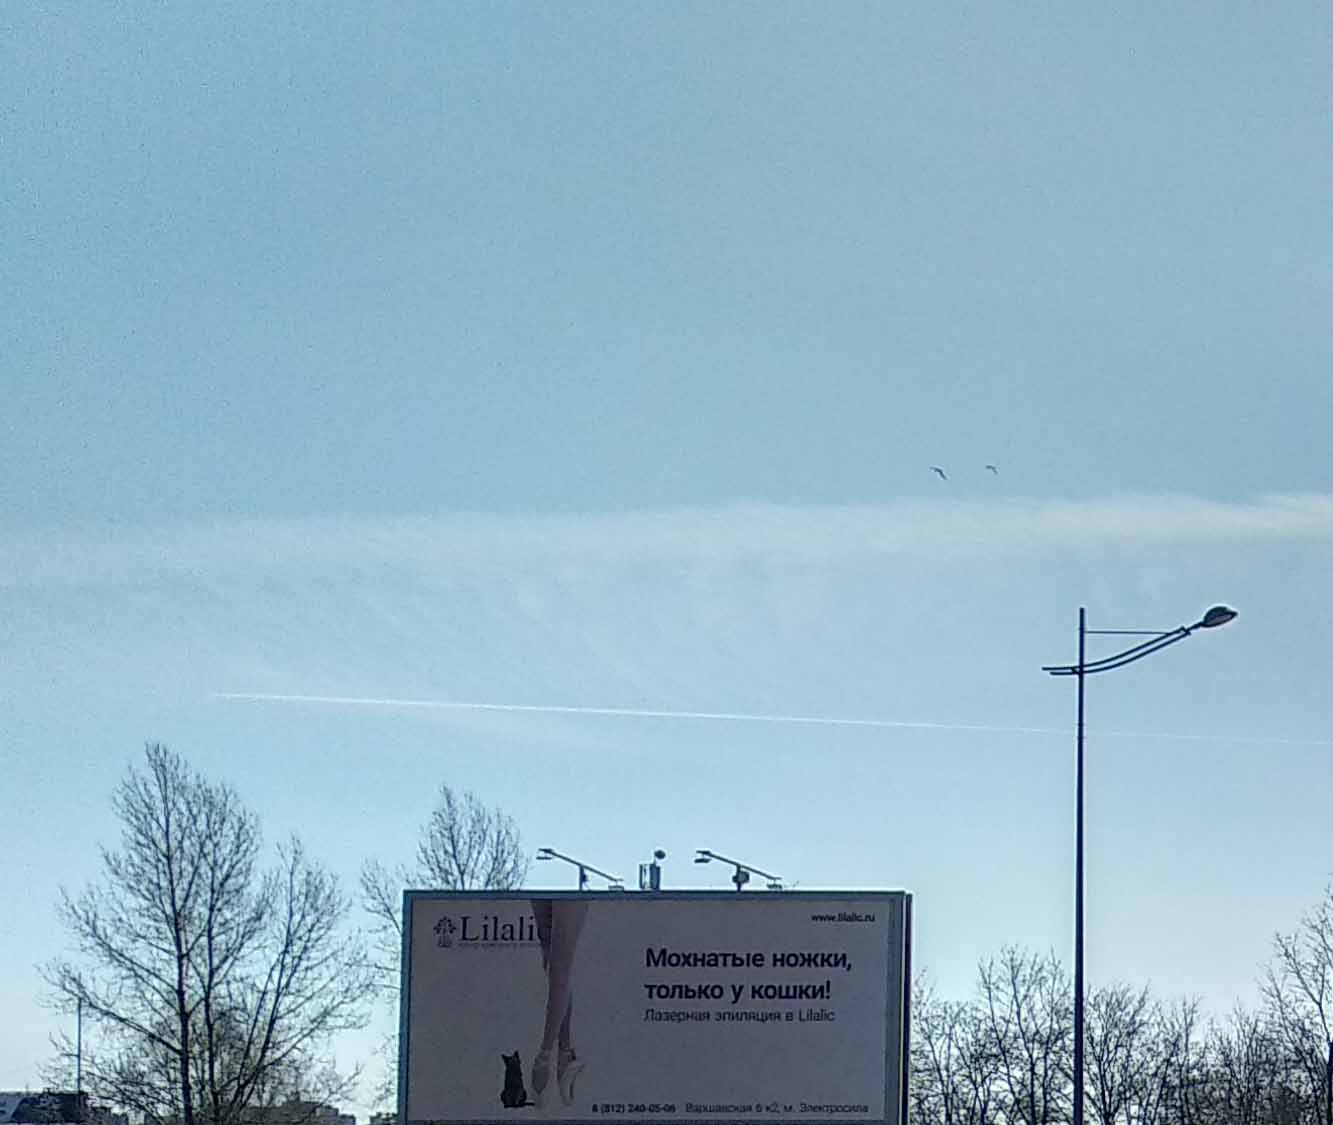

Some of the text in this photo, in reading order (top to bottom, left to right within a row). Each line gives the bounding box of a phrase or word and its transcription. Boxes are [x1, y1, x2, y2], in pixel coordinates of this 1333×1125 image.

[811, 912, 876, 923] www.lilalic.ru
[645, 948, 852, 971] Мохнатые ножки,
[644, 980, 831, 1004] только у кошки!
[644, 1008, 835, 1023] Лазерная эпиляция в Lilalic
[600, 1102, 625, 1115] (812)
